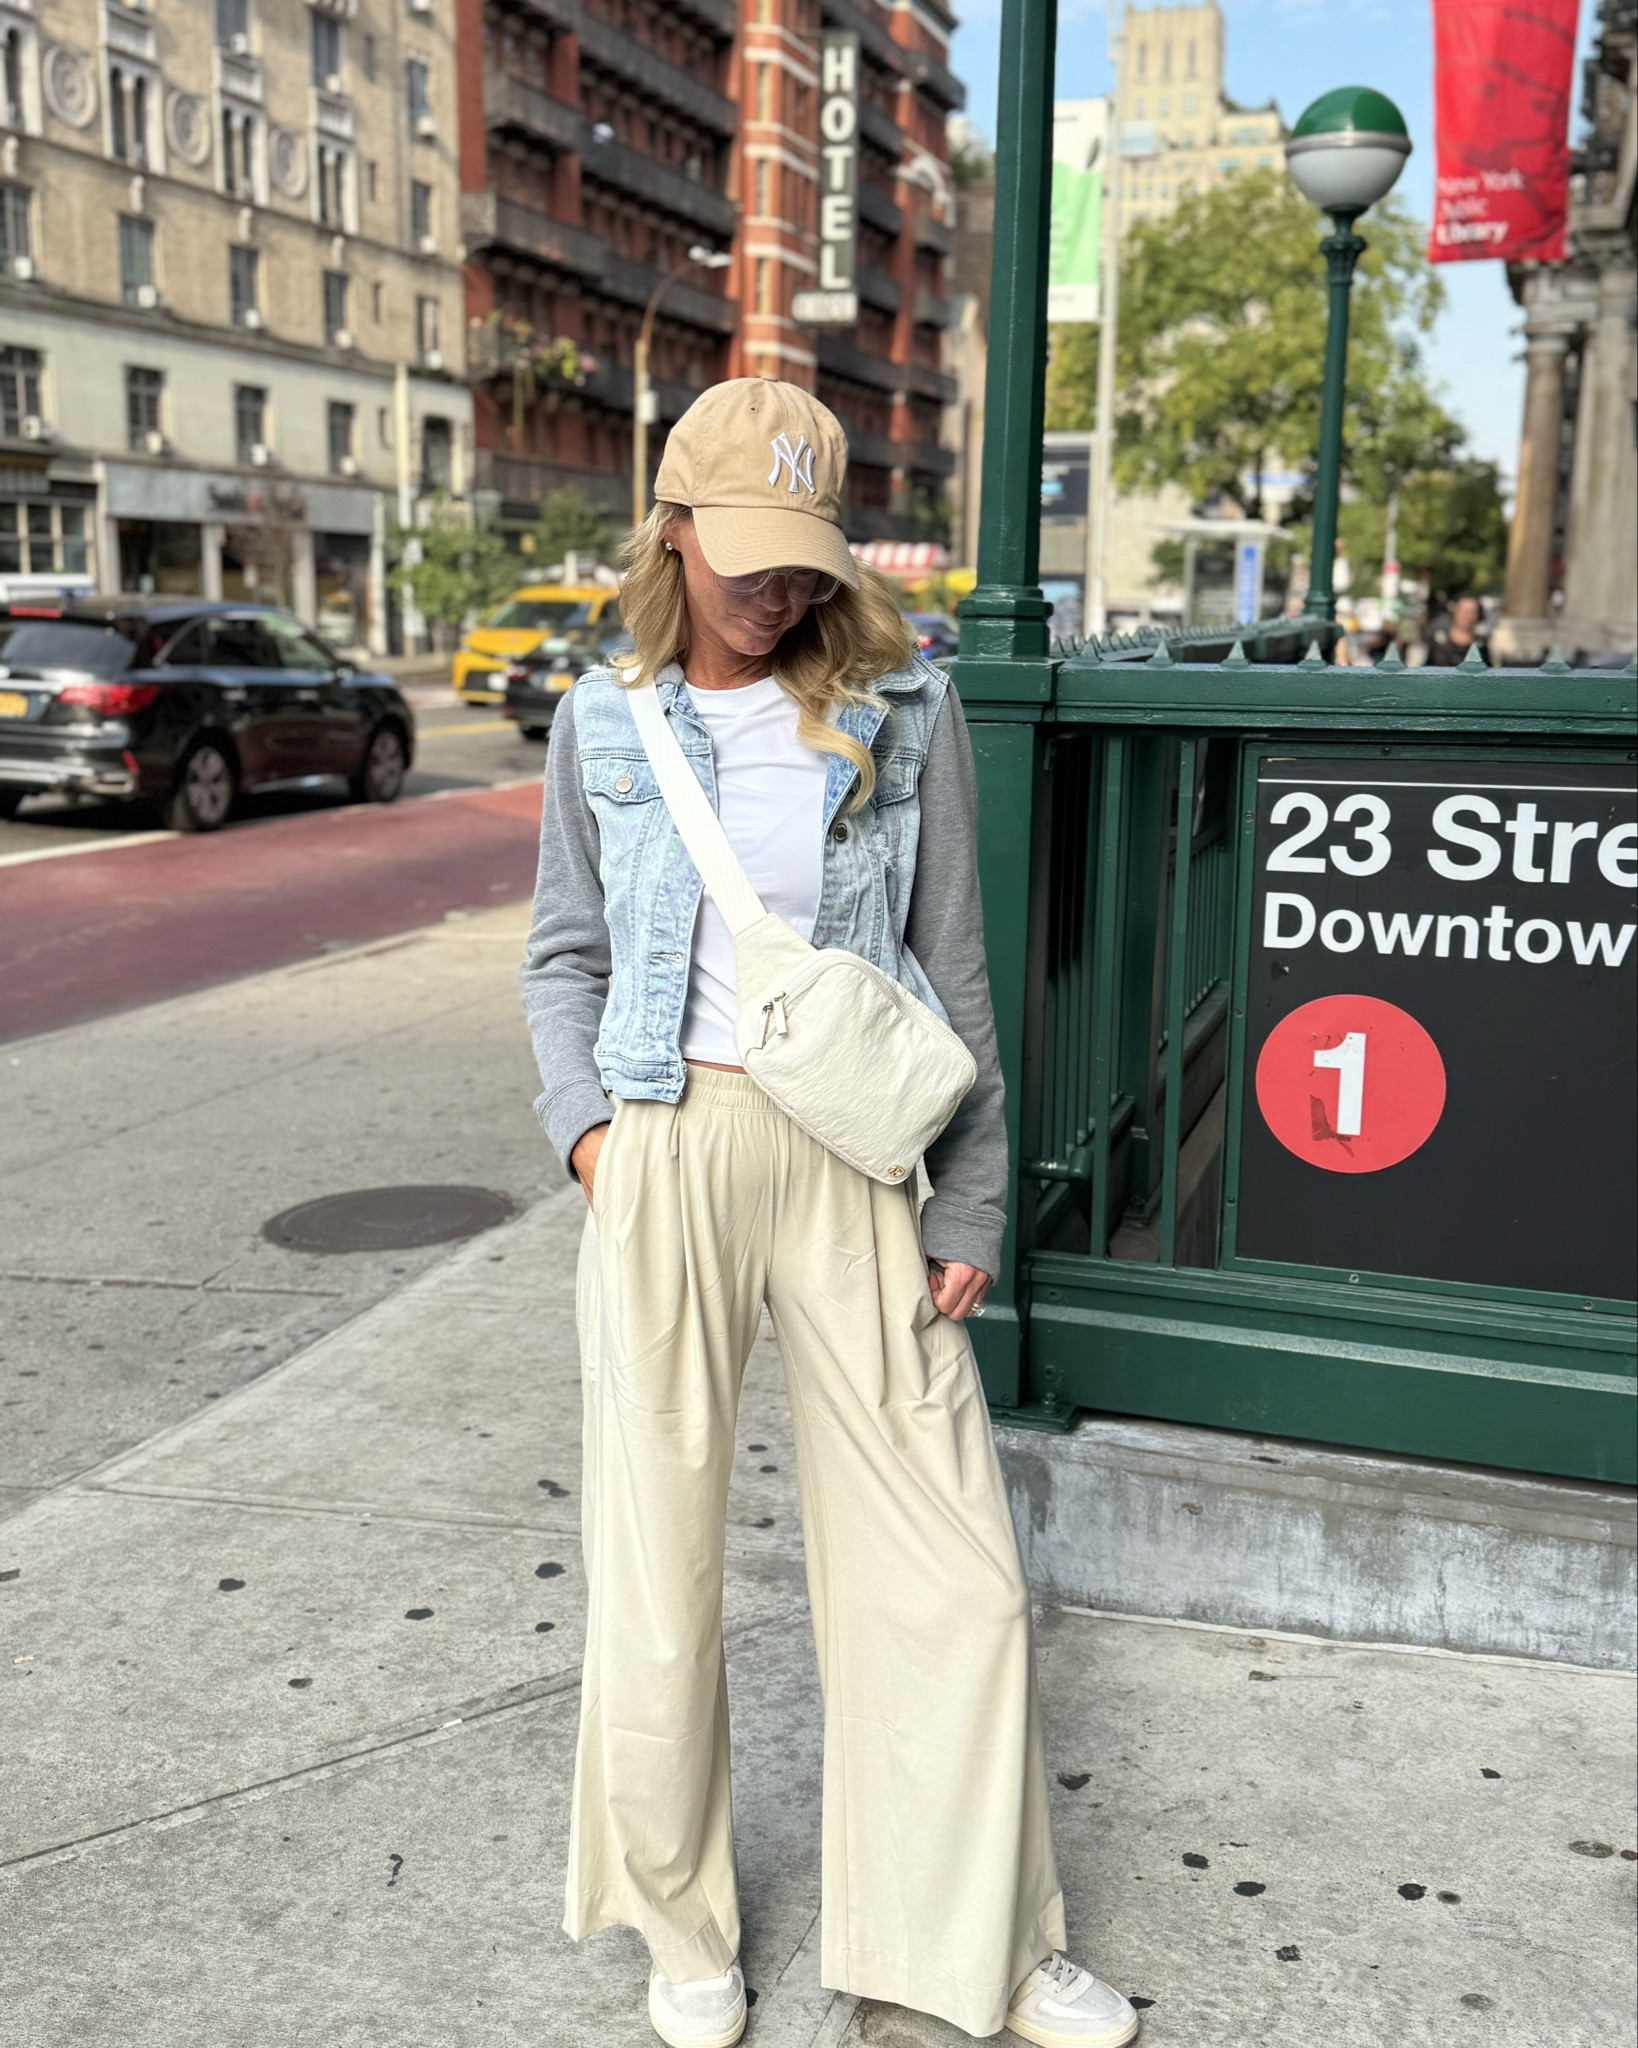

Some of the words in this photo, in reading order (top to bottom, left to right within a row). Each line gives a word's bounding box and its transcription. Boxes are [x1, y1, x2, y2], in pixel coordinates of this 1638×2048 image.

[820, 45, 856, 290] HOTEL
[1480, 168, 1525, 192] York
[1436, 221, 1509, 246] Library
[768, 431, 816, 495] NY
[1266, 792, 1392, 877] 23
[1264, 892, 1637, 967] Downtow
[1313, 1032, 1366, 1136] 1
